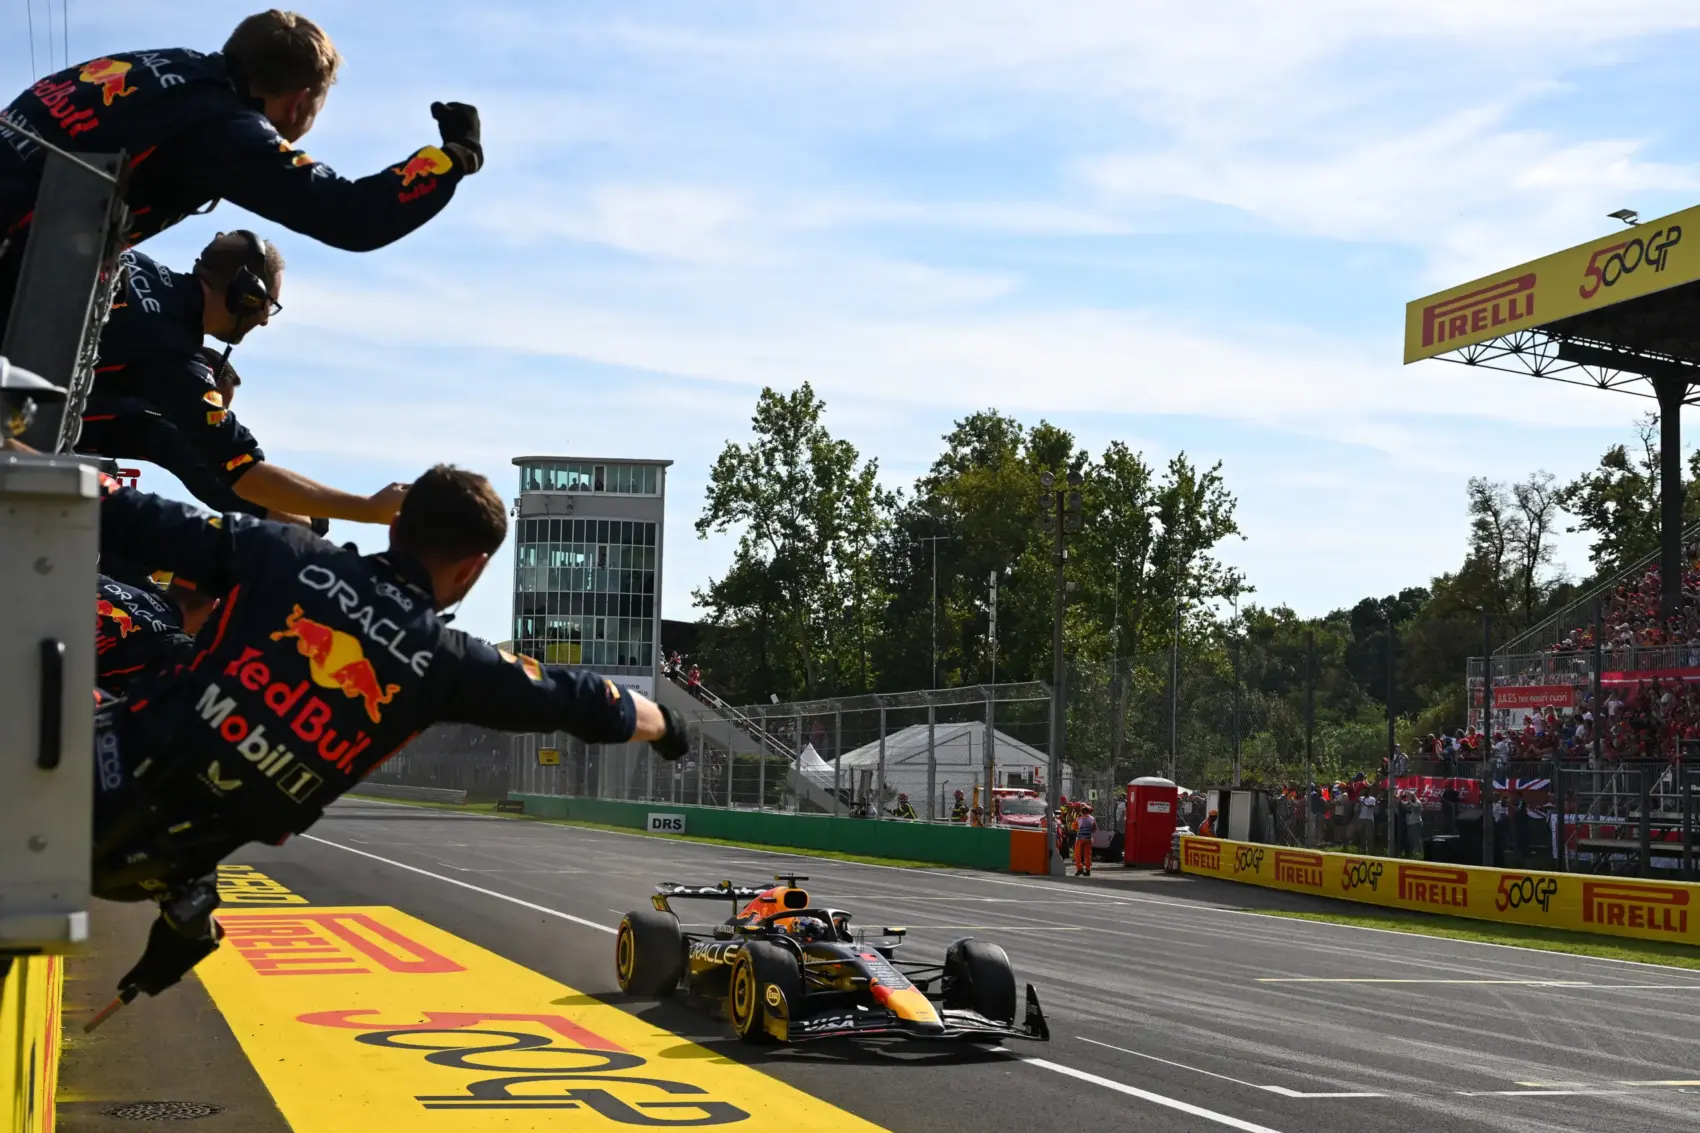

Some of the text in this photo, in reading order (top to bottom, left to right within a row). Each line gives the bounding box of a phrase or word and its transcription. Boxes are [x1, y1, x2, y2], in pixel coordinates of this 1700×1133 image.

[135, 53, 185, 88] ACLE
[119, 251, 160, 313] RACLE
[1579, 225, 1682, 299] 500GP
[1421, 273, 1537, 348] PIRELLI
[103, 584, 167, 632] ORACLE
[299, 564, 434, 678] ORACLE
[195, 682, 294, 777] Mobil
[652, 817, 682, 830] DRS
[1184, 838, 1220, 871] PIRELLI
[1233, 845, 1264, 874] 500GP
[1275, 851, 1323, 888] PIRELLI
[1342, 858, 1383, 892] 500GP
[1399, 865, 1468, 907] PIRELLI
[1495, 874, 1558, 913] 500GP
[1582, 882, 1690, 933] PIRELLI
[213, 913, 468, 976] PIRELLI
[295, 1009, 752, 1127] 500GP
